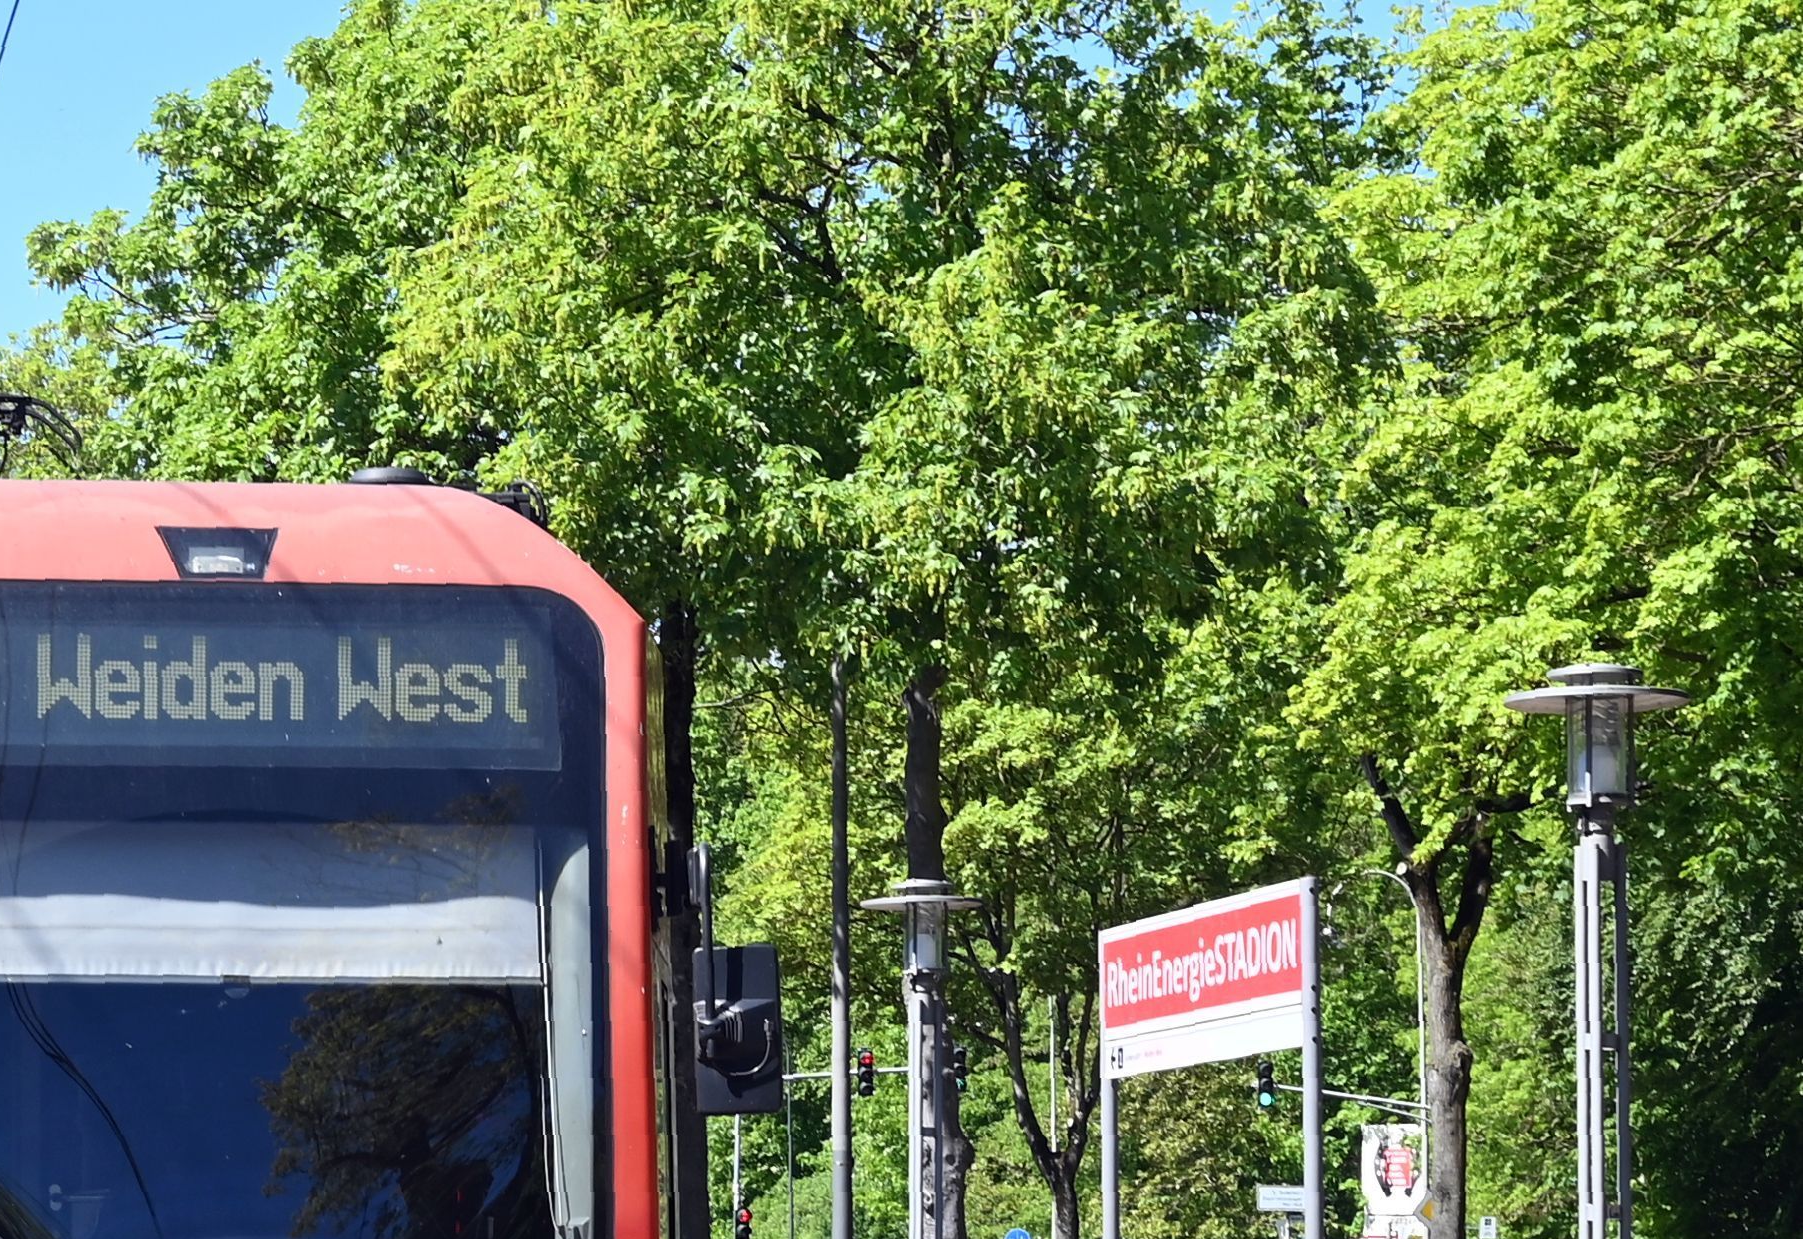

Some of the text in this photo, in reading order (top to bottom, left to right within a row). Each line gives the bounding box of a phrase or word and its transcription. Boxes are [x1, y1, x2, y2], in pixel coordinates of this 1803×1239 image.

[37, 633, 305, 722] Weiden
[336, 634, 530, 724] West
[1106, 919, 1298, 1003] RheinEnergieSTADION
